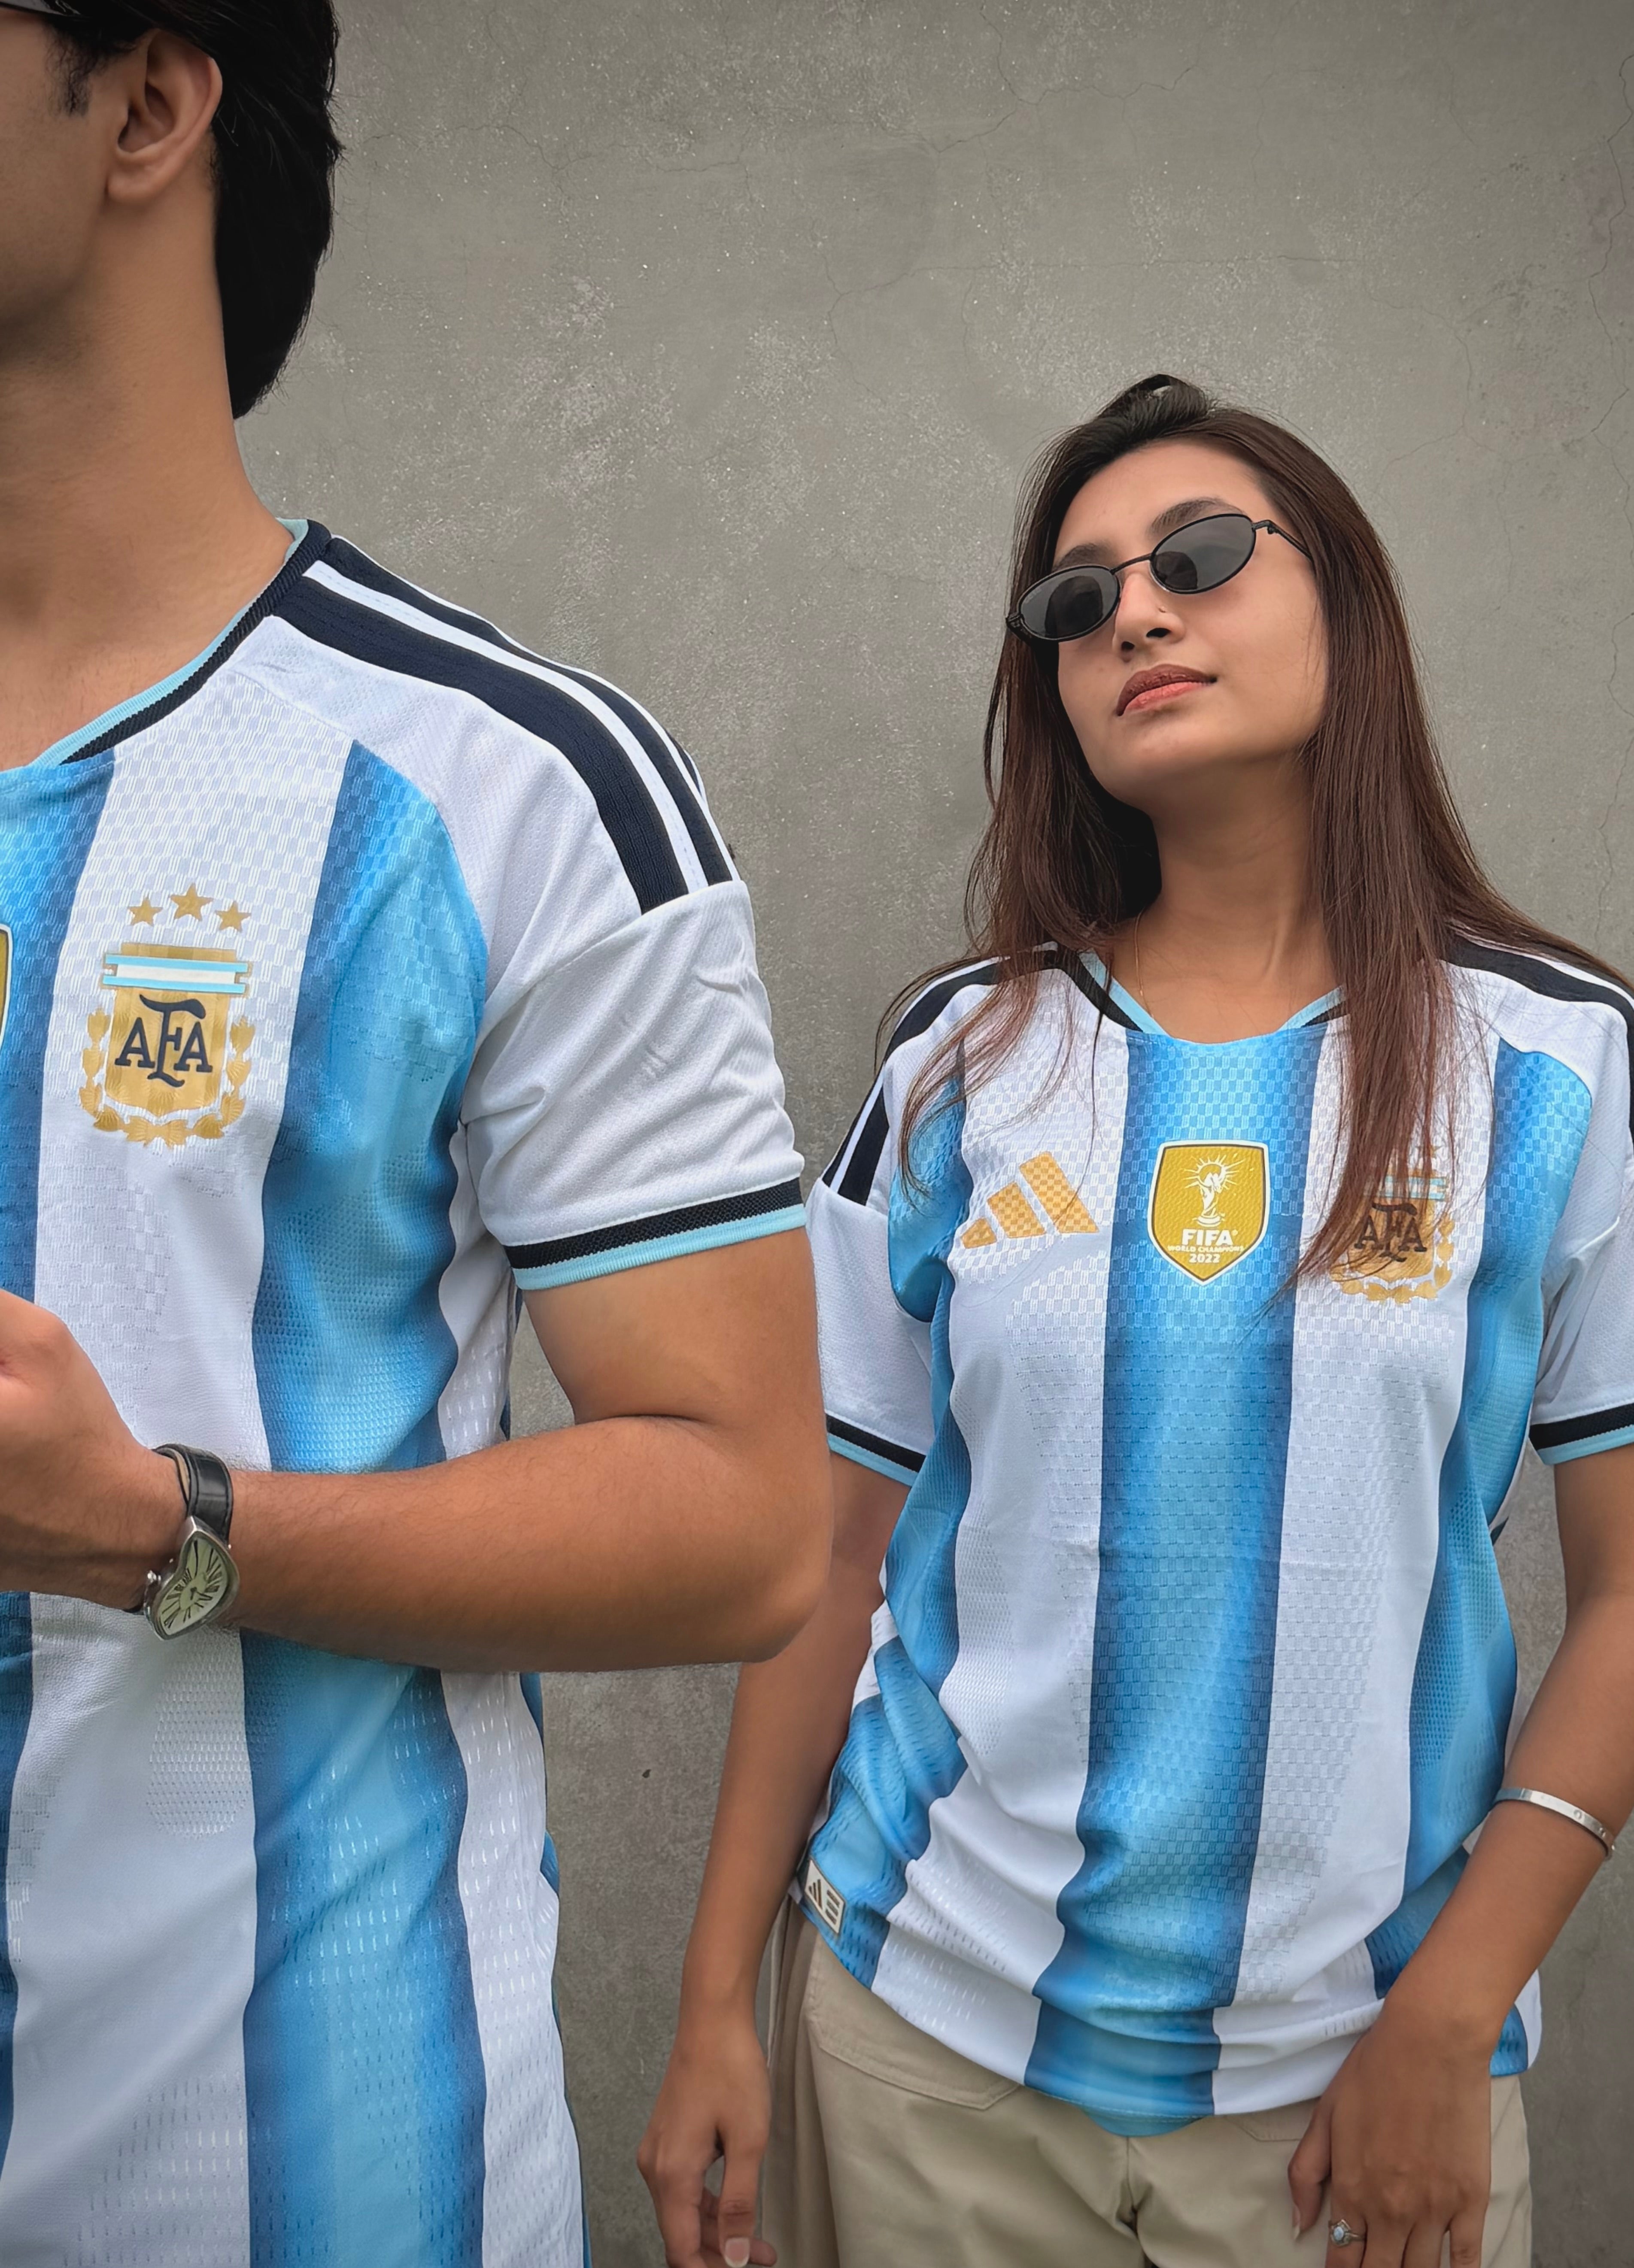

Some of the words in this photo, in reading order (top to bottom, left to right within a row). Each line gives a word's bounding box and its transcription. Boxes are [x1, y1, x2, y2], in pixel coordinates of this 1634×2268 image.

[114, 994, 213, 1088] AFA
[1182, 1229, 1233, 1246] FIFA
[1354, 1202, 1427, 1262] AFA
[1189, 1254, 1220, 1263] 2022
